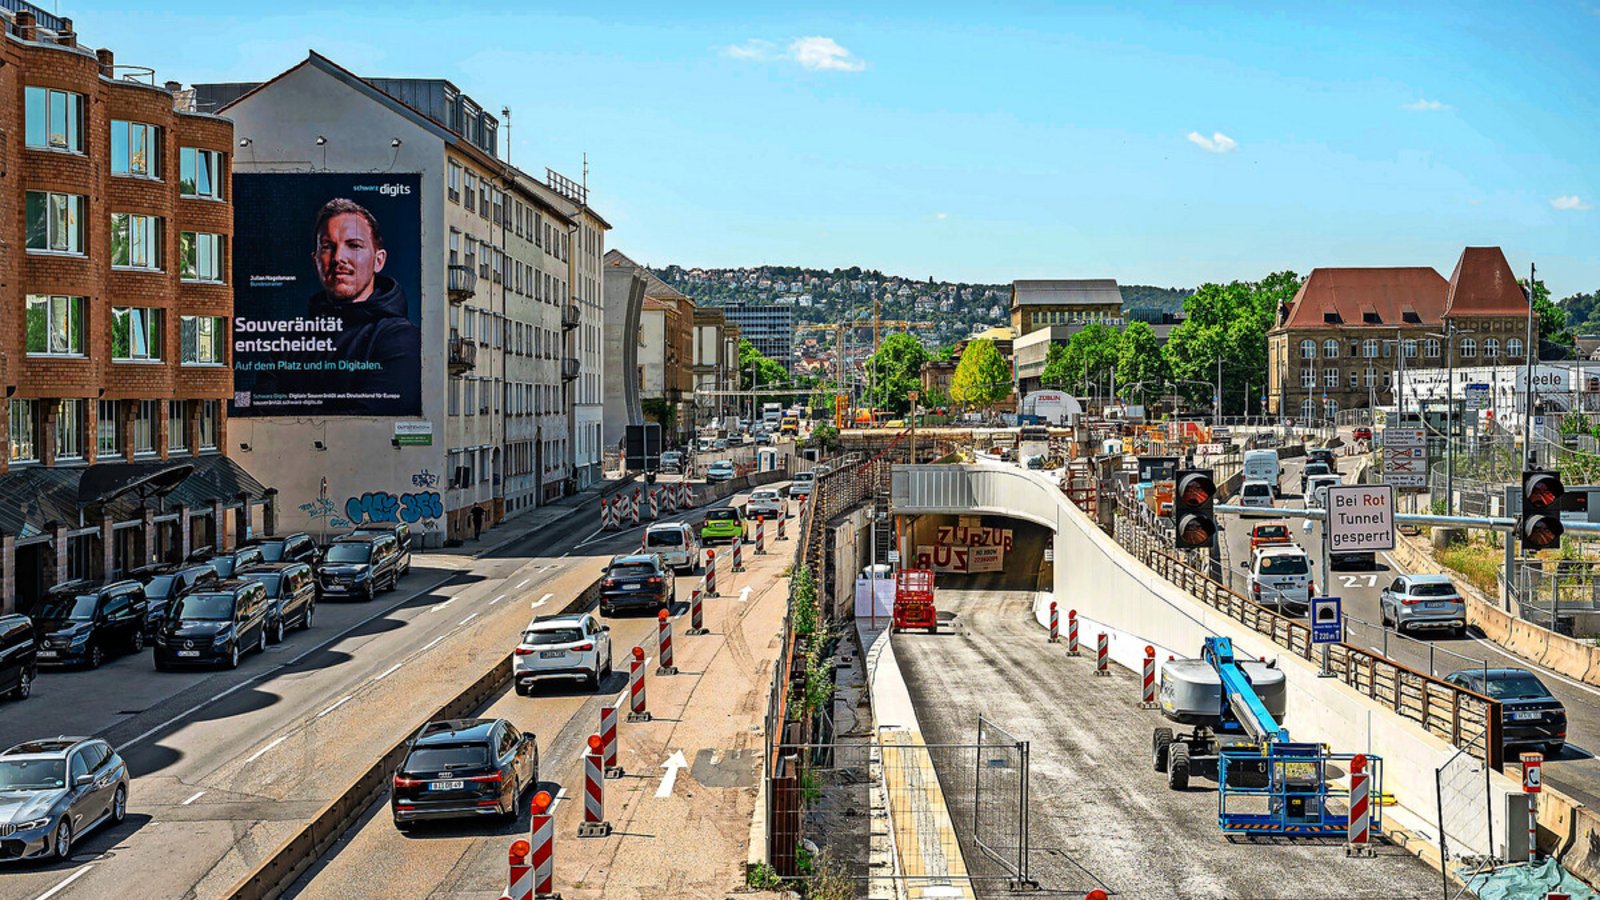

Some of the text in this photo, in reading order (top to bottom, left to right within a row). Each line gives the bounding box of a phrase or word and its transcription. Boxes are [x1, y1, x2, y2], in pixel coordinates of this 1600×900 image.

[380, 183, 411, 197] digits
[235, 317, 343, 332] Souveränität
[235, 337, 337, 352] entscheidet.
[235, 360, 383, 372] Auf dem Platz und im Digitalen.
[1336, 494, 1385, 507] Bei Rot
[1338, 512, 1385, 525] Tunnel
[1333, 530, 1390, 546] gesperrt
[1338, 575, 1378, 588] 27
